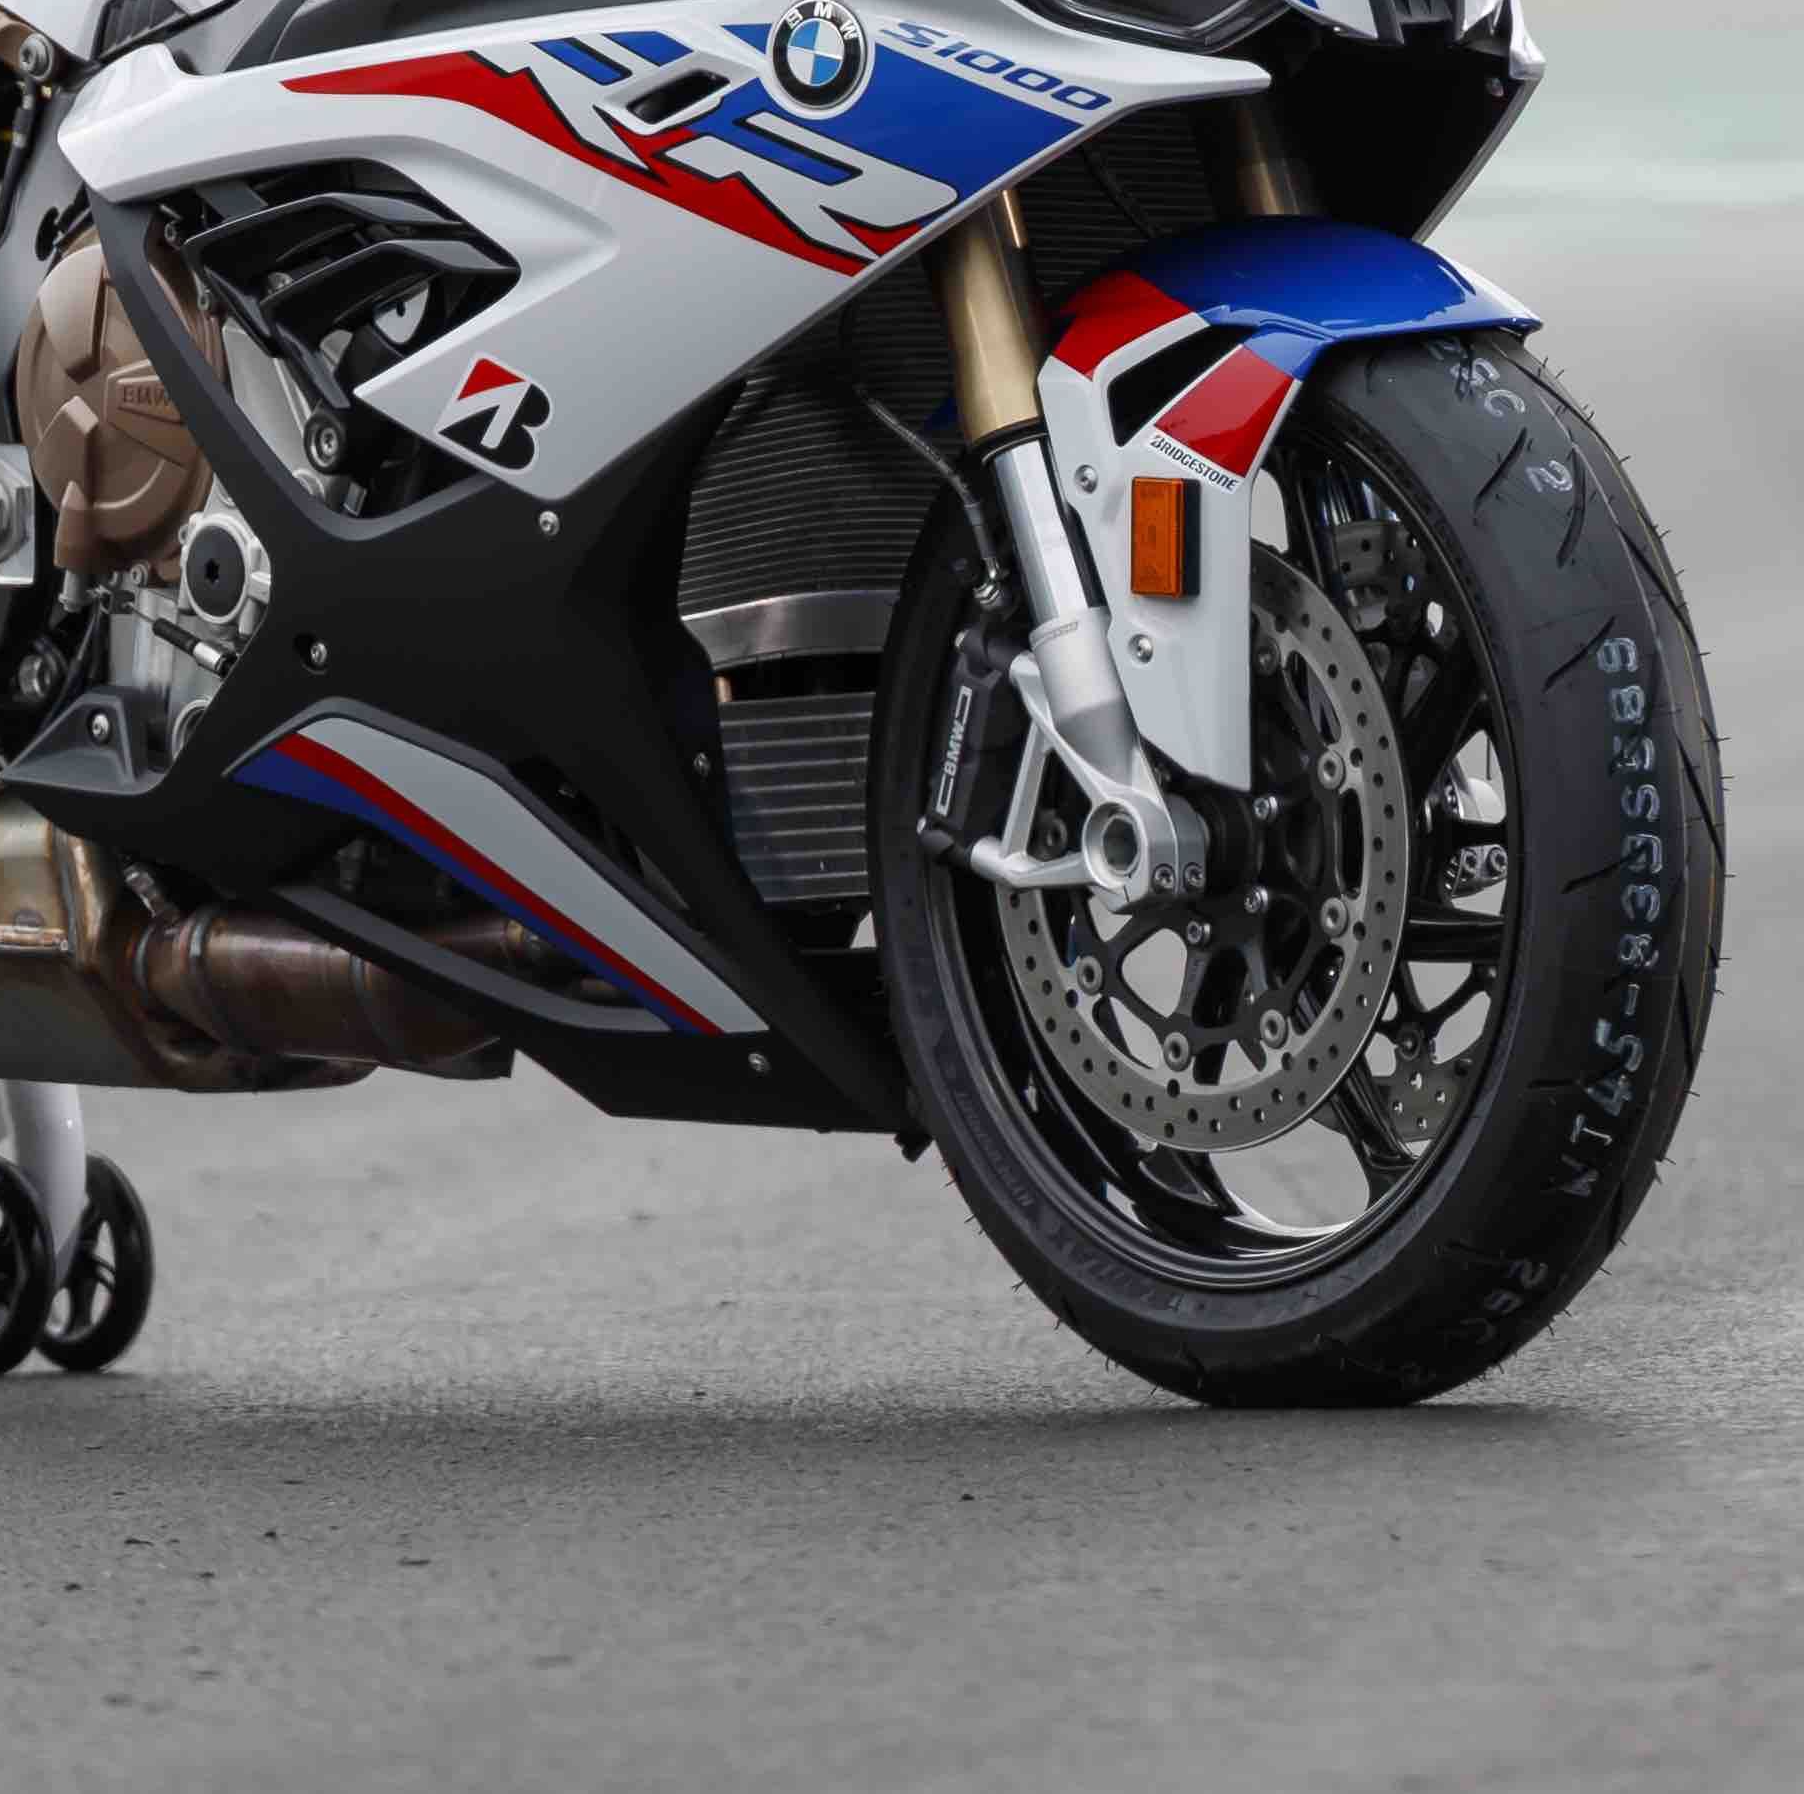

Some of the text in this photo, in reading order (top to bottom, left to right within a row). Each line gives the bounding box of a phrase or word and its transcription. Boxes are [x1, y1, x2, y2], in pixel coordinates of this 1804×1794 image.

[787, 0, 861, 41] BMW
[877, 20, 1113, 112] S1000
[1149, 432, 1240, 493] BRIDGESTONE
[942, 714, 967, 777] BMW
